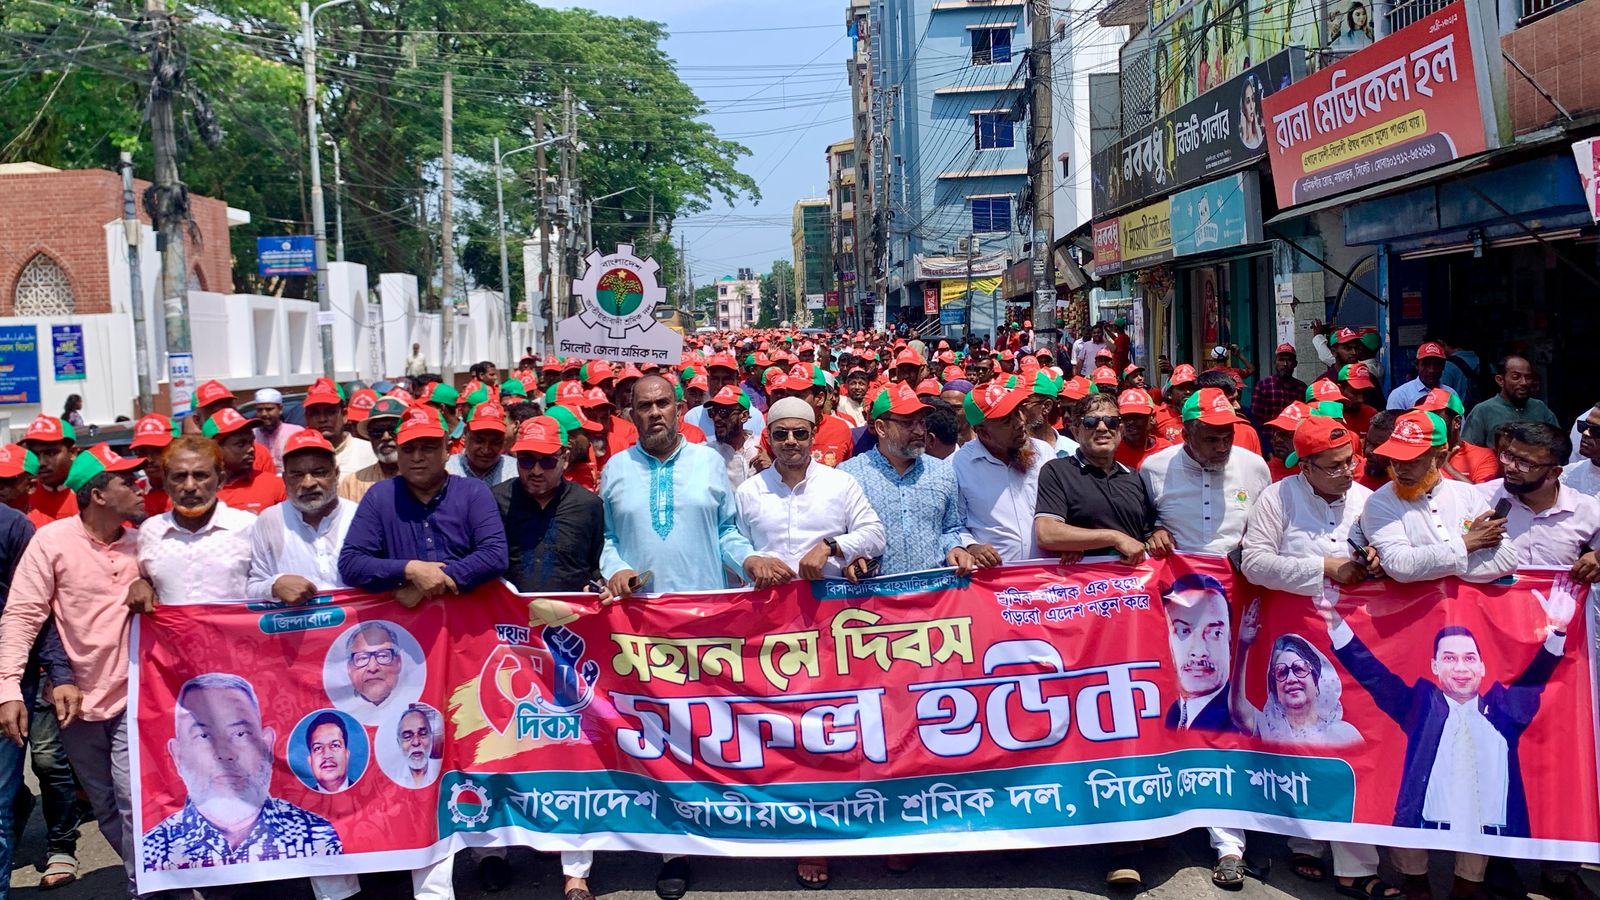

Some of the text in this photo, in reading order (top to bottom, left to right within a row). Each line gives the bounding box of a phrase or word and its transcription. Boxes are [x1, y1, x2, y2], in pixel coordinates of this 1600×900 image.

[1273, 34, 1457, 154] রানা মেডিকেল হল
[1175, 113, 1200, 157] বিউটি
[1201, 101, 1230, 145] পার্লার
[600, 258, 642, 272] বাংলাদেশ
[560, 340, 669, 359] সিলেট জেলা শ্রমিক দল
[1084, 579, 1109, 595] এক
[272, 611, 333, 631] জিন্দাবাদ
[1001, 594, 1150, 626] গড়বো এদেশ নতুন করে
[495, 624, 530, 644] মহান
[610, 607, 975, 691] মহান মে দিবস
[516, 701, 582, 740] দিবস
[607, 639, 1161, 770] সফল হউক
[506, 786, 661, 822] বাংলাদেশ
[671, 788, 888, 829] জাতীয়তাবাদী
[898, 782, 996, 825] শ্রমিক
[1004, 782, 1077, 818] দল,
[1085, 763, 1172, 808] সিলেট
[1177, 763, 1237, 797] জেলা
[1244, 767, 1311, 806] শাখা
